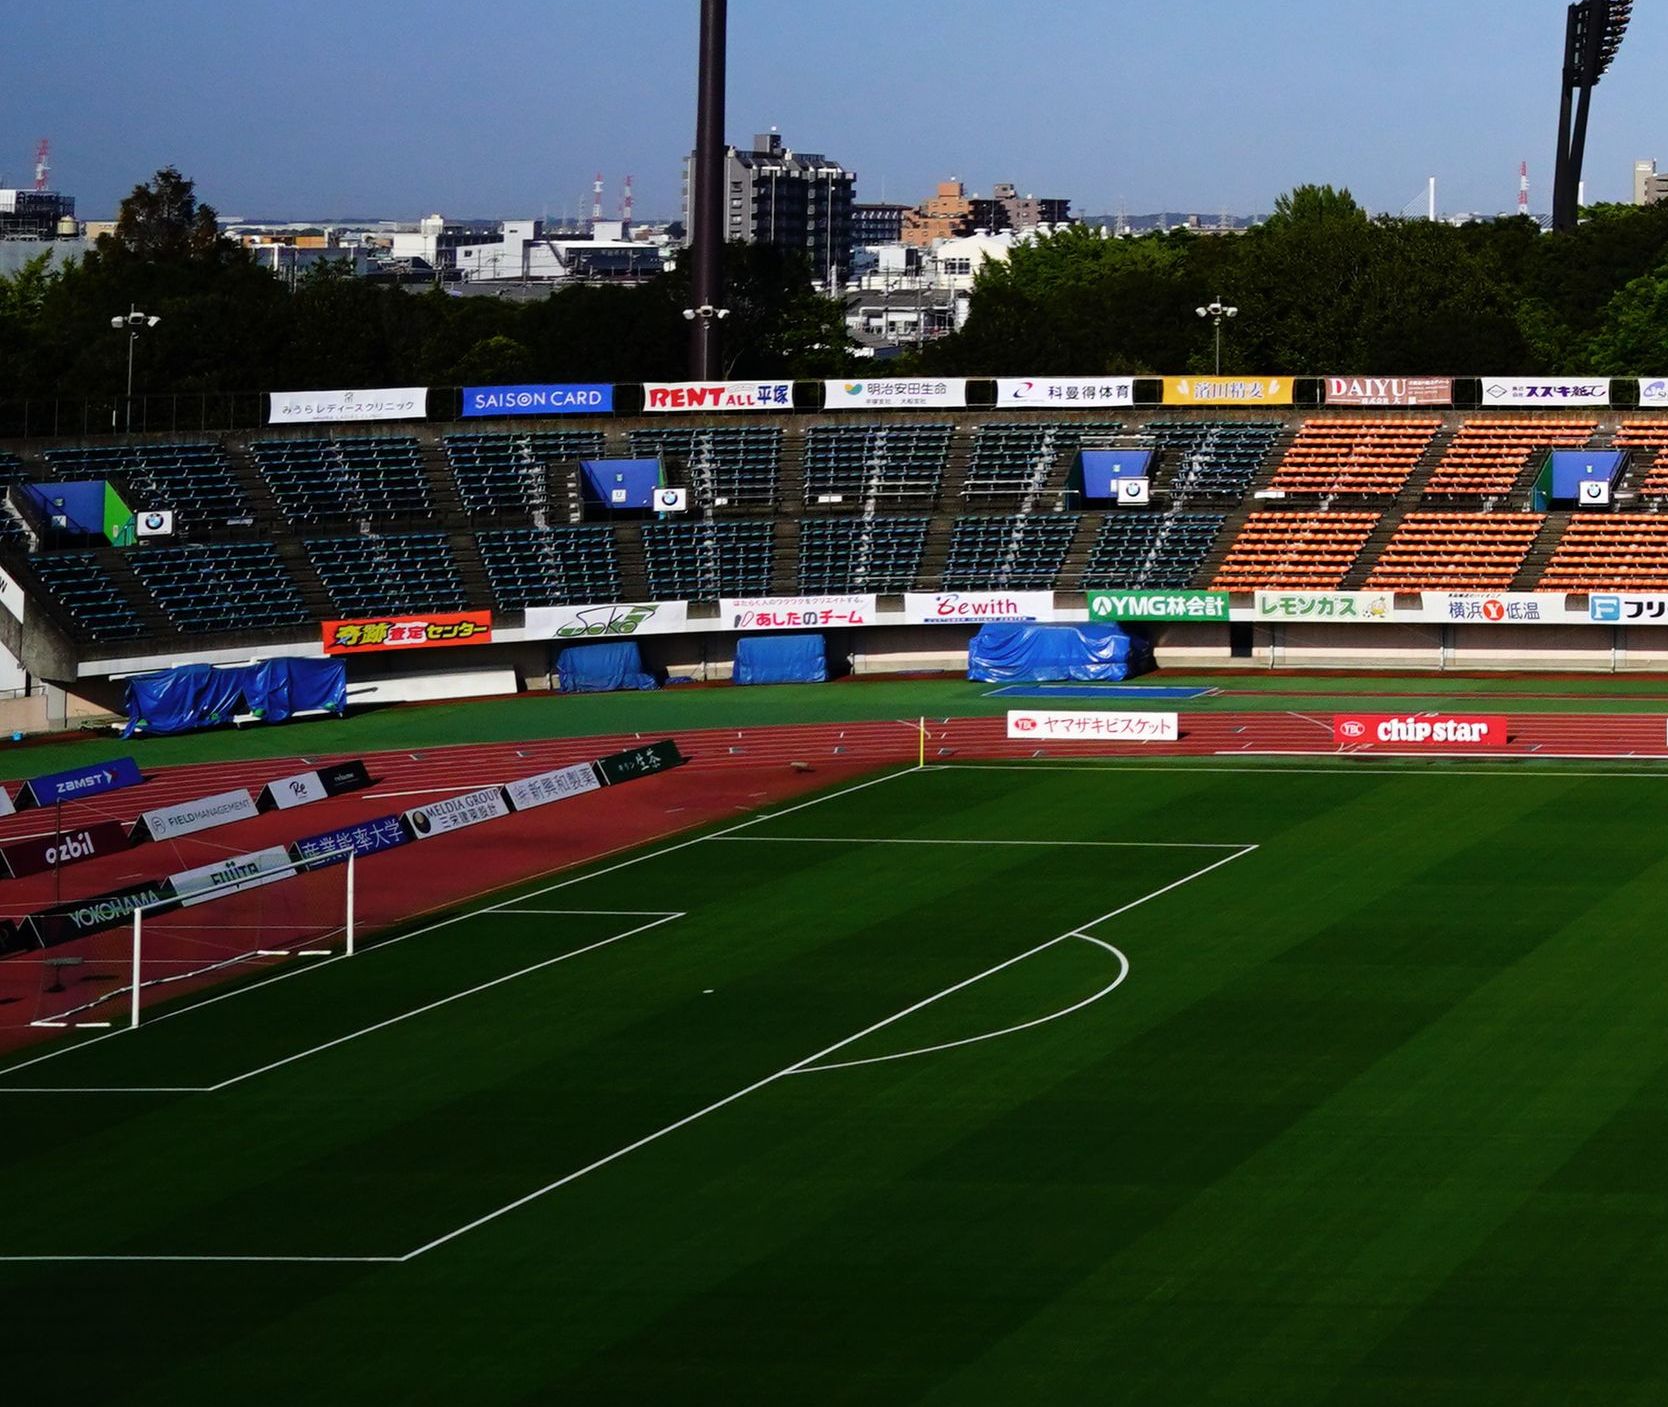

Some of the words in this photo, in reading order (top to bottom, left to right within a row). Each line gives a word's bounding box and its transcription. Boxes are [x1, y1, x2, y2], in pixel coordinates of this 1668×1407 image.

[649, 388, 725, 408] RENT
[726, 394, 755, 406] ALL
[757, 385, 789, 405] 平塚
[867, 383, 947, 396] 明治安田生命
[1328, 378, 1407, 397] DAIYU
[282, 401, 414, 414] みうらレディースクリニック
[475, 391, 547, 409] SAISON
[550, 390, 602, 407] CARD
[1111, 596, 1224, 616] YMG林会計
[1262, 596, 1358, 616] レモンガス
[755, 609, 863, 626] あしたのチーム
[336, 622, 488, 645] 奇跡査定センター
[1044, 717, 1170, 734] ヤマザキビスケット
[1377, 718, 1432, 741] chip
[1432, 721, 1489, 741] star
[426, 798, 465, 818] MELDIA
[465, 788, 500, 808] GROUP
[69, 889, 161, 929] YOKOHAMA
